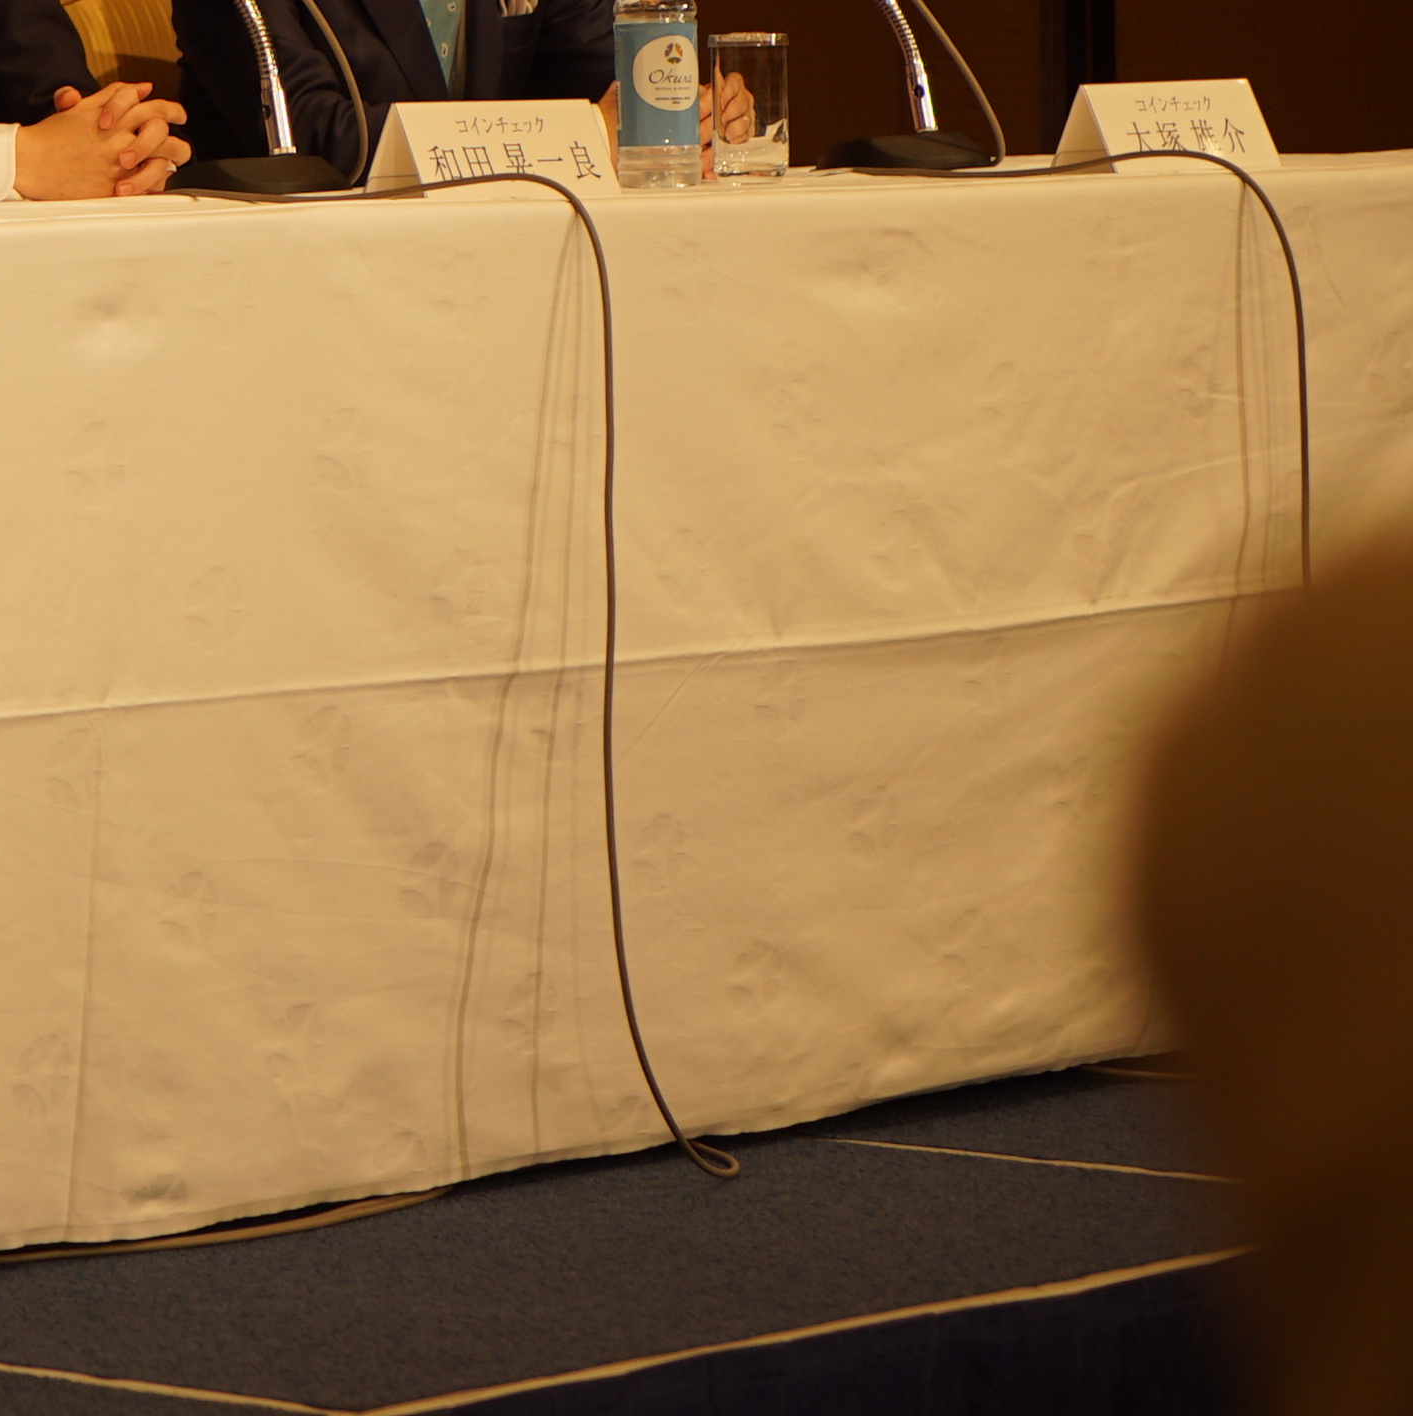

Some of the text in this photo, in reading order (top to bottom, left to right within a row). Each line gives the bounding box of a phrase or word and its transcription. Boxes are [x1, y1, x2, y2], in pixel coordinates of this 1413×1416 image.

[1136, 95, 1212, 114] コインチェック
[455, 115, 545, 136] コインチェック
